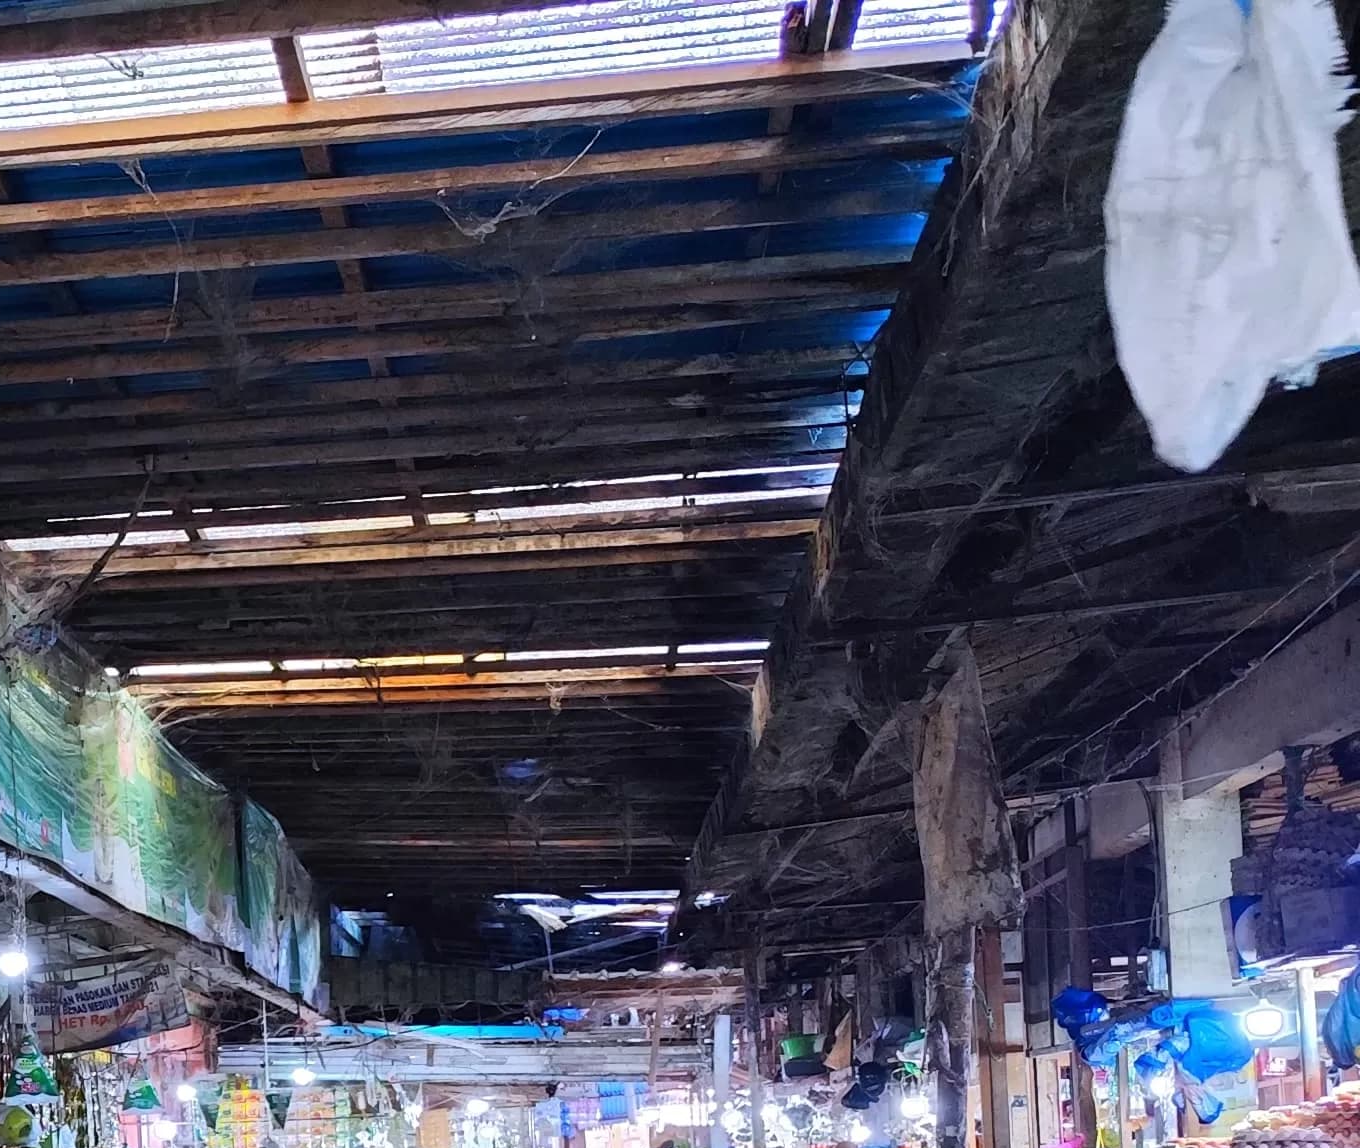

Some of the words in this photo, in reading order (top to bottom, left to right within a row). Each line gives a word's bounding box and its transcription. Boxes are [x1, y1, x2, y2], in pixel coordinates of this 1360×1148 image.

[76, 986, 112, 1004] PASOKAN
[113, 982, 129, 995] DAN
[88, 997, 119, 1014] MEDIUM
[61, 1016, 86, 1030] HET
